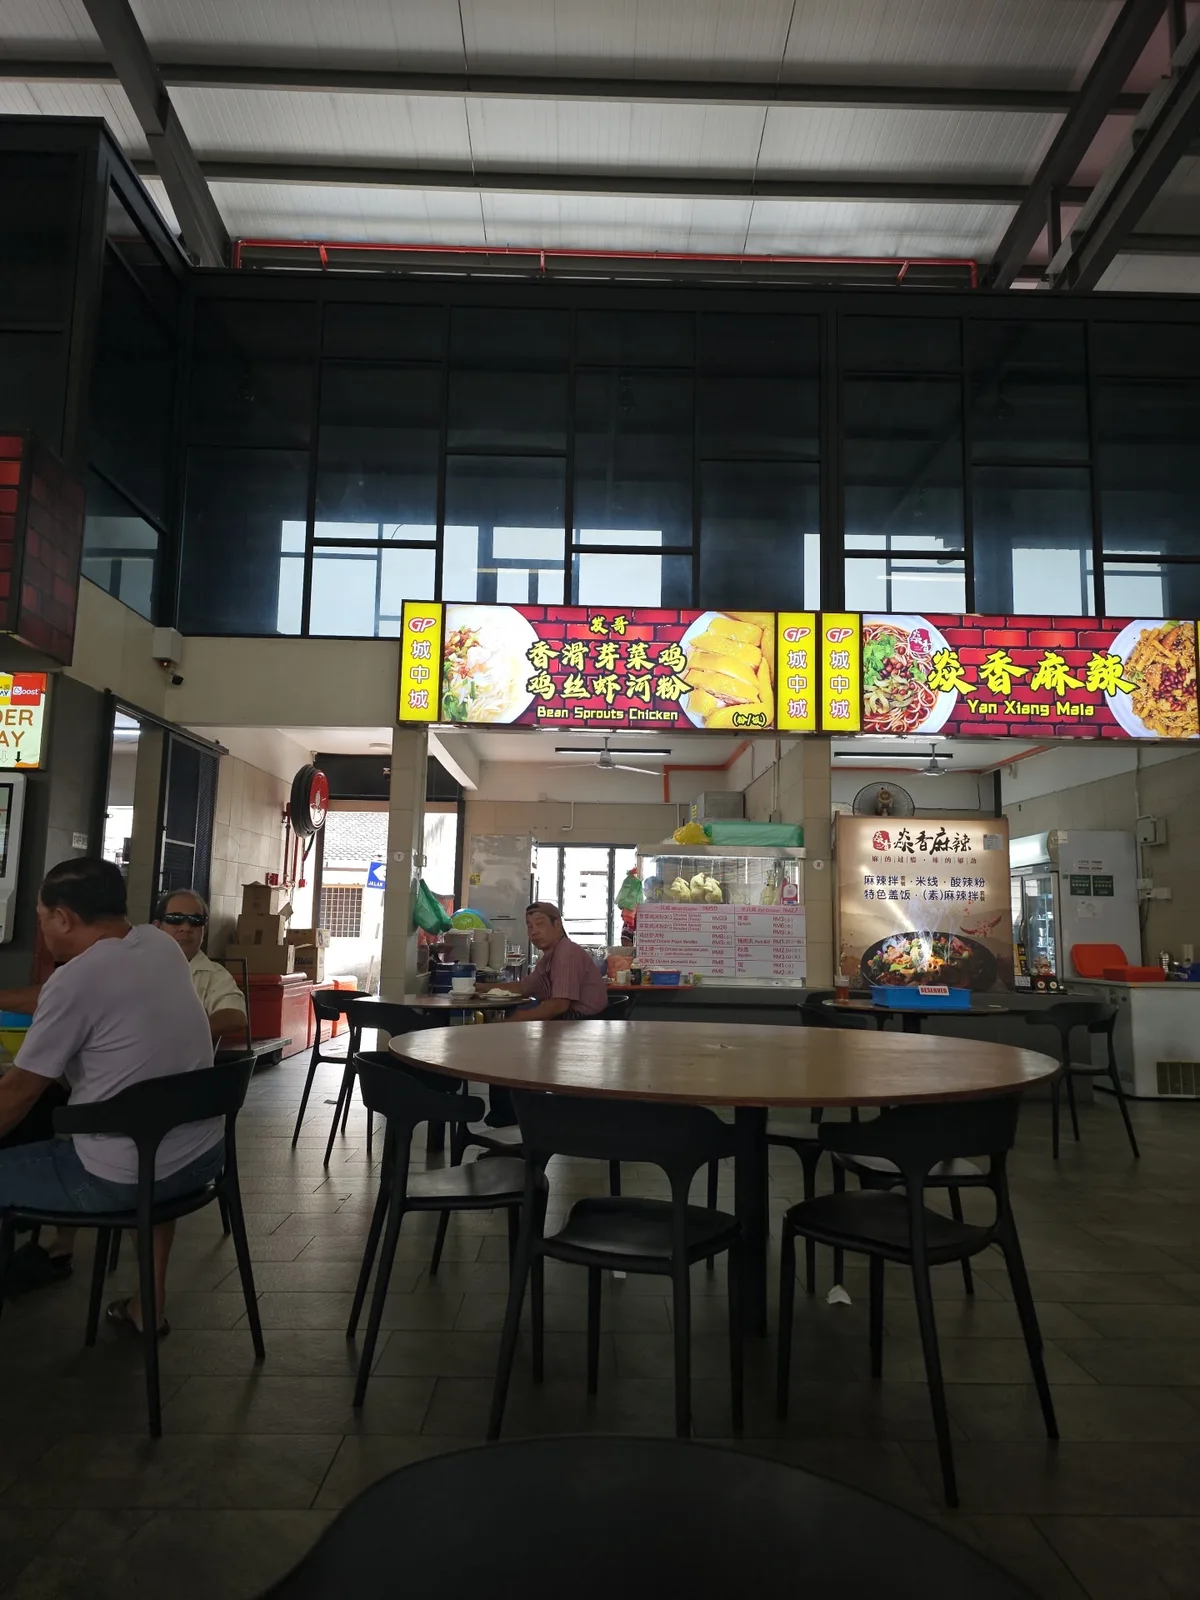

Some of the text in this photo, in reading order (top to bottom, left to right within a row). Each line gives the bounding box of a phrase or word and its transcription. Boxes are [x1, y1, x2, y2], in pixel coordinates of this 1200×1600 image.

[408, 616, 437, 634] GP
[589, 614, 629, 636] 发哥
[783, 626, 811, 643] GP
[826, 627, 855, 643] GP
[527, 640, 688, 672] 香滑芽菜鸡
[408, 640, 432, 710] 城中城
[787, 650, 809, 719] 城中城
[830, 650, 850, 719] 城中城
[526, 672, 693, 704] 鸡丝虾河粉
[0, 709, 33, 726] ER
[537, 705, 679, 721] Bean Sprouts Chicken
[966, 699, 1095, 718] Yan Xiang Mala
[864, 875, 899, 886] 麻辣拌
[916, 876, 939, 887] 米线
[950, 876, 986, 888] 酸辣粉
